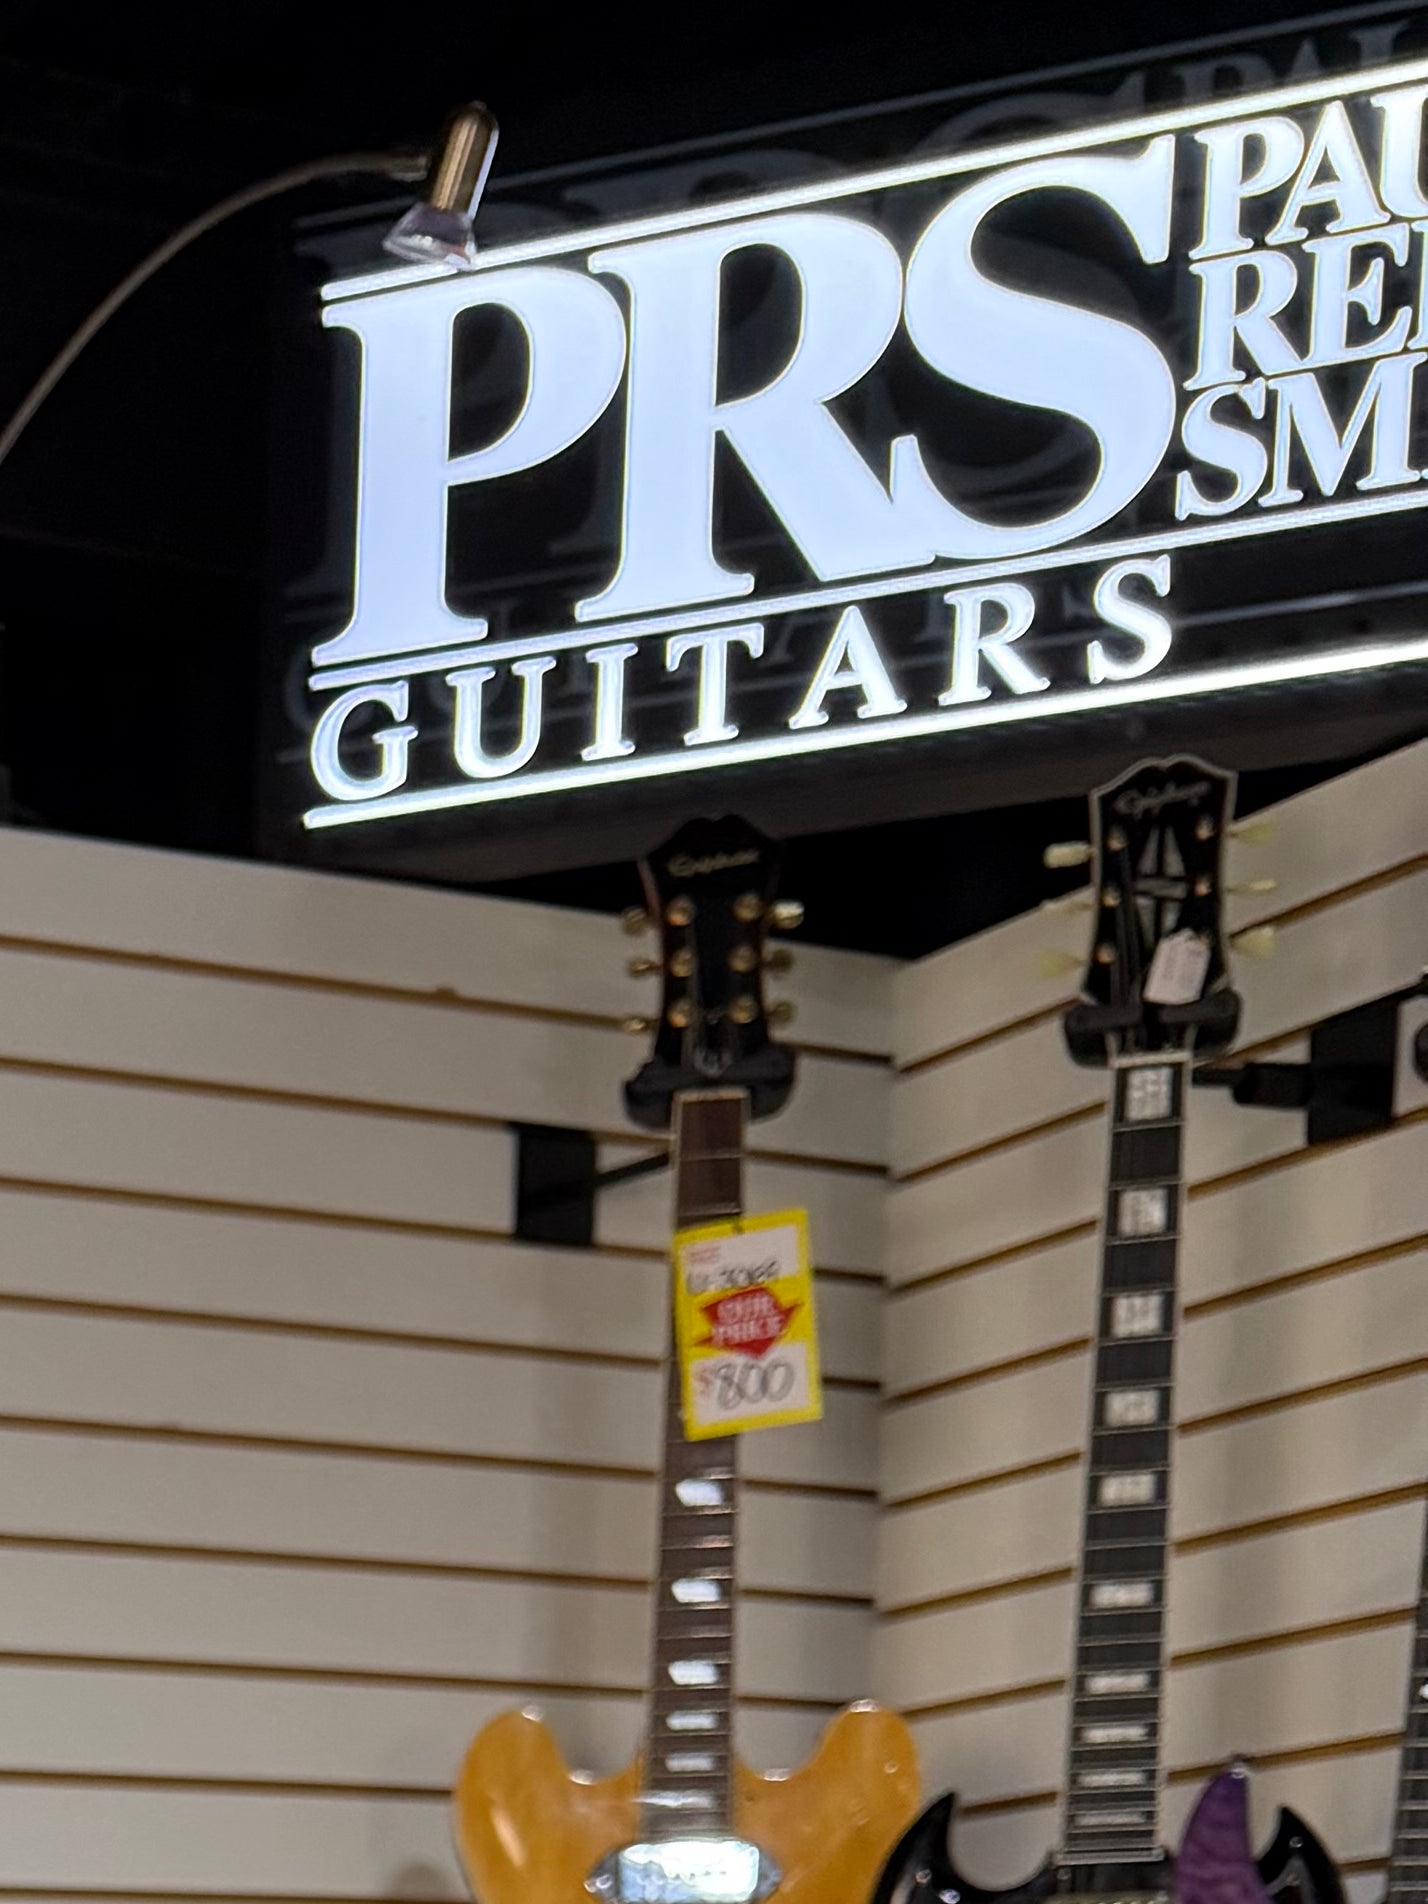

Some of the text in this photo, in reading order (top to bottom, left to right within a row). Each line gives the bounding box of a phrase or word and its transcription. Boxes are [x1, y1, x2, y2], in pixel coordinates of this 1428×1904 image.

[312, 133, 1175, 668] PRS
[1183, 221, 1428, 391] RE
[1175, 352, 1428, 521] SM
[310, 553, 1173, 801] GUITARS
